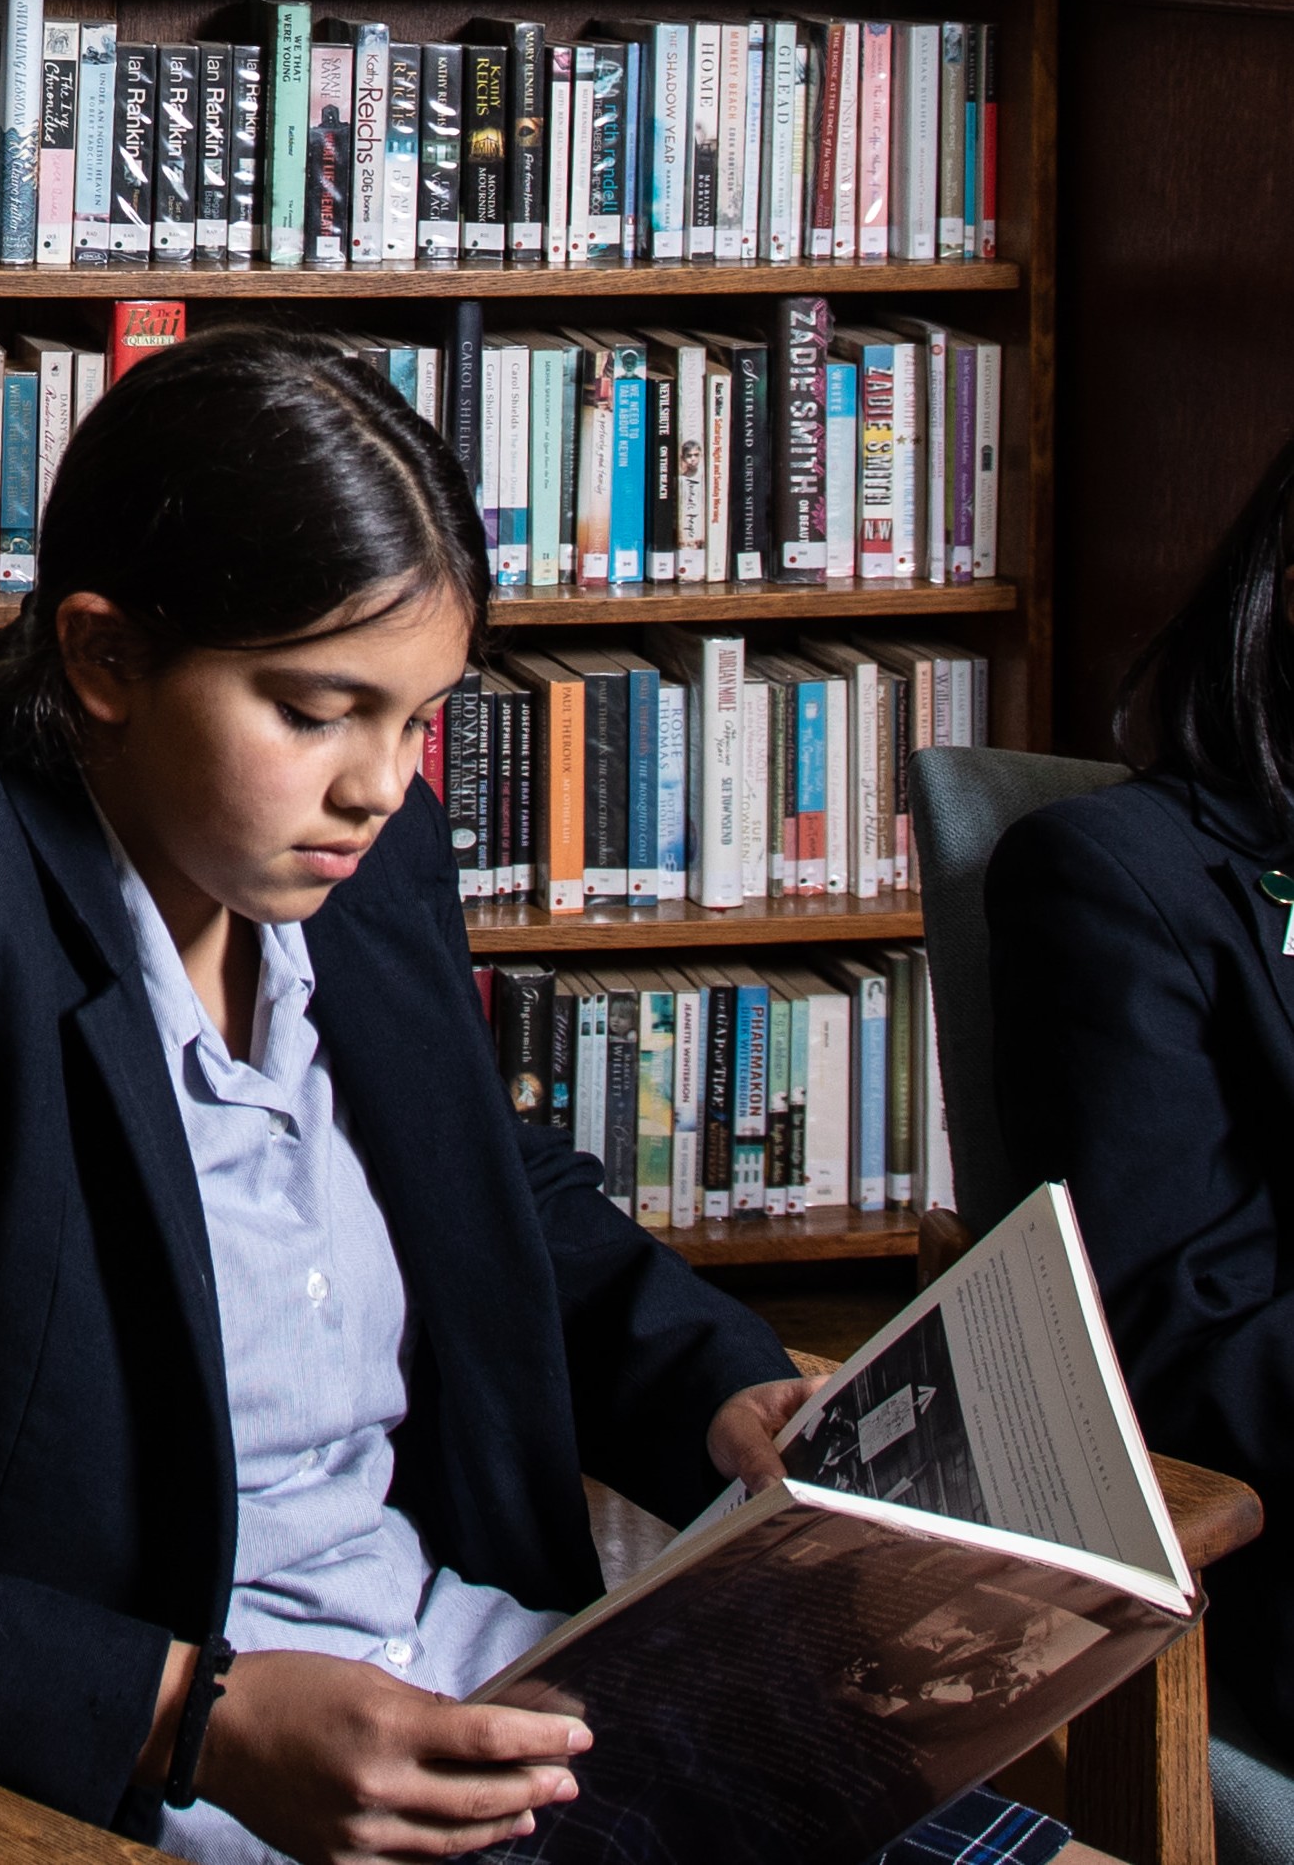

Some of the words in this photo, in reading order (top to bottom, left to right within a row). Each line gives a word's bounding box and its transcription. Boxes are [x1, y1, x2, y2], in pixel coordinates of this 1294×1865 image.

[14, 1, 28, 68] SWIMMING
[283, 14, 291, 42] WERE
[293, 35, 302, 52] WE
[525, 31, 535, 62] MARY
[128, 56, 143, 82] Ian
[170, 56, 186, 82] Ian
[207, 55, 224, 81] Ian
[282, 46, 291, 82] YOUNG
[293, 55, 302, 82] THAT
[359, 54, 379, 88] Kathy
[700, 42, 714, 107] HOME
[728, 31, 739, 78] MONKEY
[60, 72, 73, 99] The
[98, 73, 106, 106] UNDER
[321, 58, 332, 98] RAYNE
[330, 58, 342, 98] SARAH
[475, 58, 489, 116] REICHS
[489, 65, 501, 108] KATHY
[524, 64, 534, 112] RENAULT
[665, 52, 678, 120] SHADOW
[776, 45, 791, 124] GILEAD
[14, 72, 26, 127] LESSONS
[43, 62, 59, 144] Chronicles
[728, 83, 738, 119] BEACH
[126, 88, 146, 158] Rankin
[356, 88, 383, 164] Reichs
[664, 125, 676, 164] YEAR
[94, 169, 103, 206] HEAVEN
[362, 168, 374, 192] 206
[487, 174, 496, 220] MONDAY
[363, 195, 373, 222] bones
[124, 308, 181, 336] Raj
[461, 341, 473, 392] CAROL
[789, 310, 817, 391] ZADIE
[485, 364, 494, 392] Carol
[511, 363, 520, 390] Carol
[629, 384, 639, 398] WE
[659, 383, 669, 410] NEVIL
[59, 393, 68, 434] DANNY
[485, 394, 494, 430] Shields
[510, 393, 520, 430] Shields
[629, 402, 639, 425] NEED
[865, 366, 893, 432] ZADIE
[458, 399, 471, 461] SHIELDS
[619, 409, 629, 437] ABOUT
[618, 440, 628, 467] KEVIN
[790, 401, 817, 493] SMITH
[865, 440, 892, 505] SMITH
[718, 649, 737, 685] ADRIAN
[450, 691, 462, 719] THE
[562, 687, 572, 714] PAUL
[718, 686, 737, 713] MOLE
[450, 721, 461, 767] SECRET
[462, 693, 479, 756] DONNA
[479, 701, 488, 755] JOSEPHINE
[502, 703, 510, 755] JOSEPHINE
[521, 703, 530, 756] JOSEPHINE
[671, 708, 683, 758] ROSIE
[562, 718, 572, 774] THEROUX
[479, 758, 488, 775] TEY
[502, 760, 510, 777] TEY
[521, 761, 529, 777] TEY
[461, 760, 477, 819] TARTT
[522, 987, 539, 1063] Fingersmith
[683, 1003, 693, 1045] JEANETTE
[682, 1048, 692, 1103] WINTERSON
[749, 1006, 764, 1117] PHARMAKON
